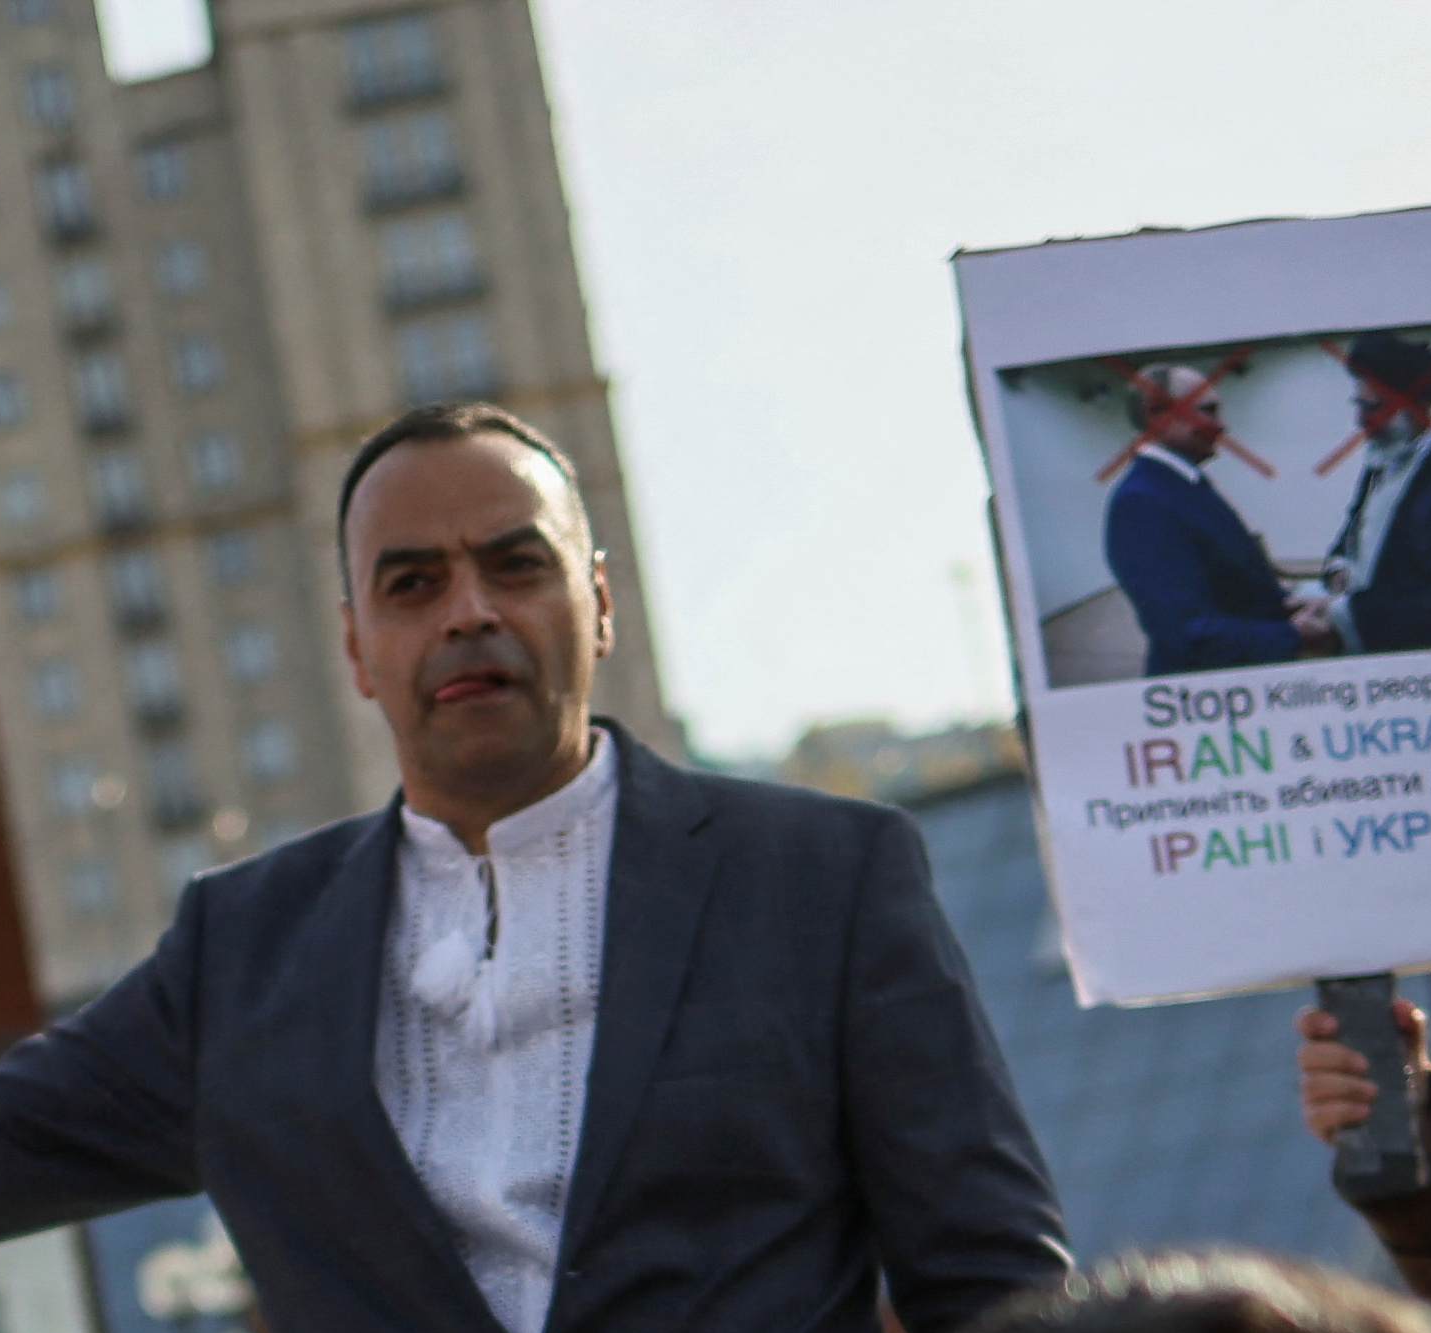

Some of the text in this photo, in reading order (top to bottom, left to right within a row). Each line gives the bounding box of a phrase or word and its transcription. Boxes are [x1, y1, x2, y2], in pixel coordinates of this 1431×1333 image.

[1144, 684, 1254, 729] Stop
[1266, 680, 1357, 709] Killing
[1124, 728, 1274, 787] IRAN
[1291, 734, 1314, 760] &
[1087, 786, 1269, 829] Припиніть
[1278, 775, 1423, 808] вбивати
[1149, 821, 1292, 874] ІРАНІ
